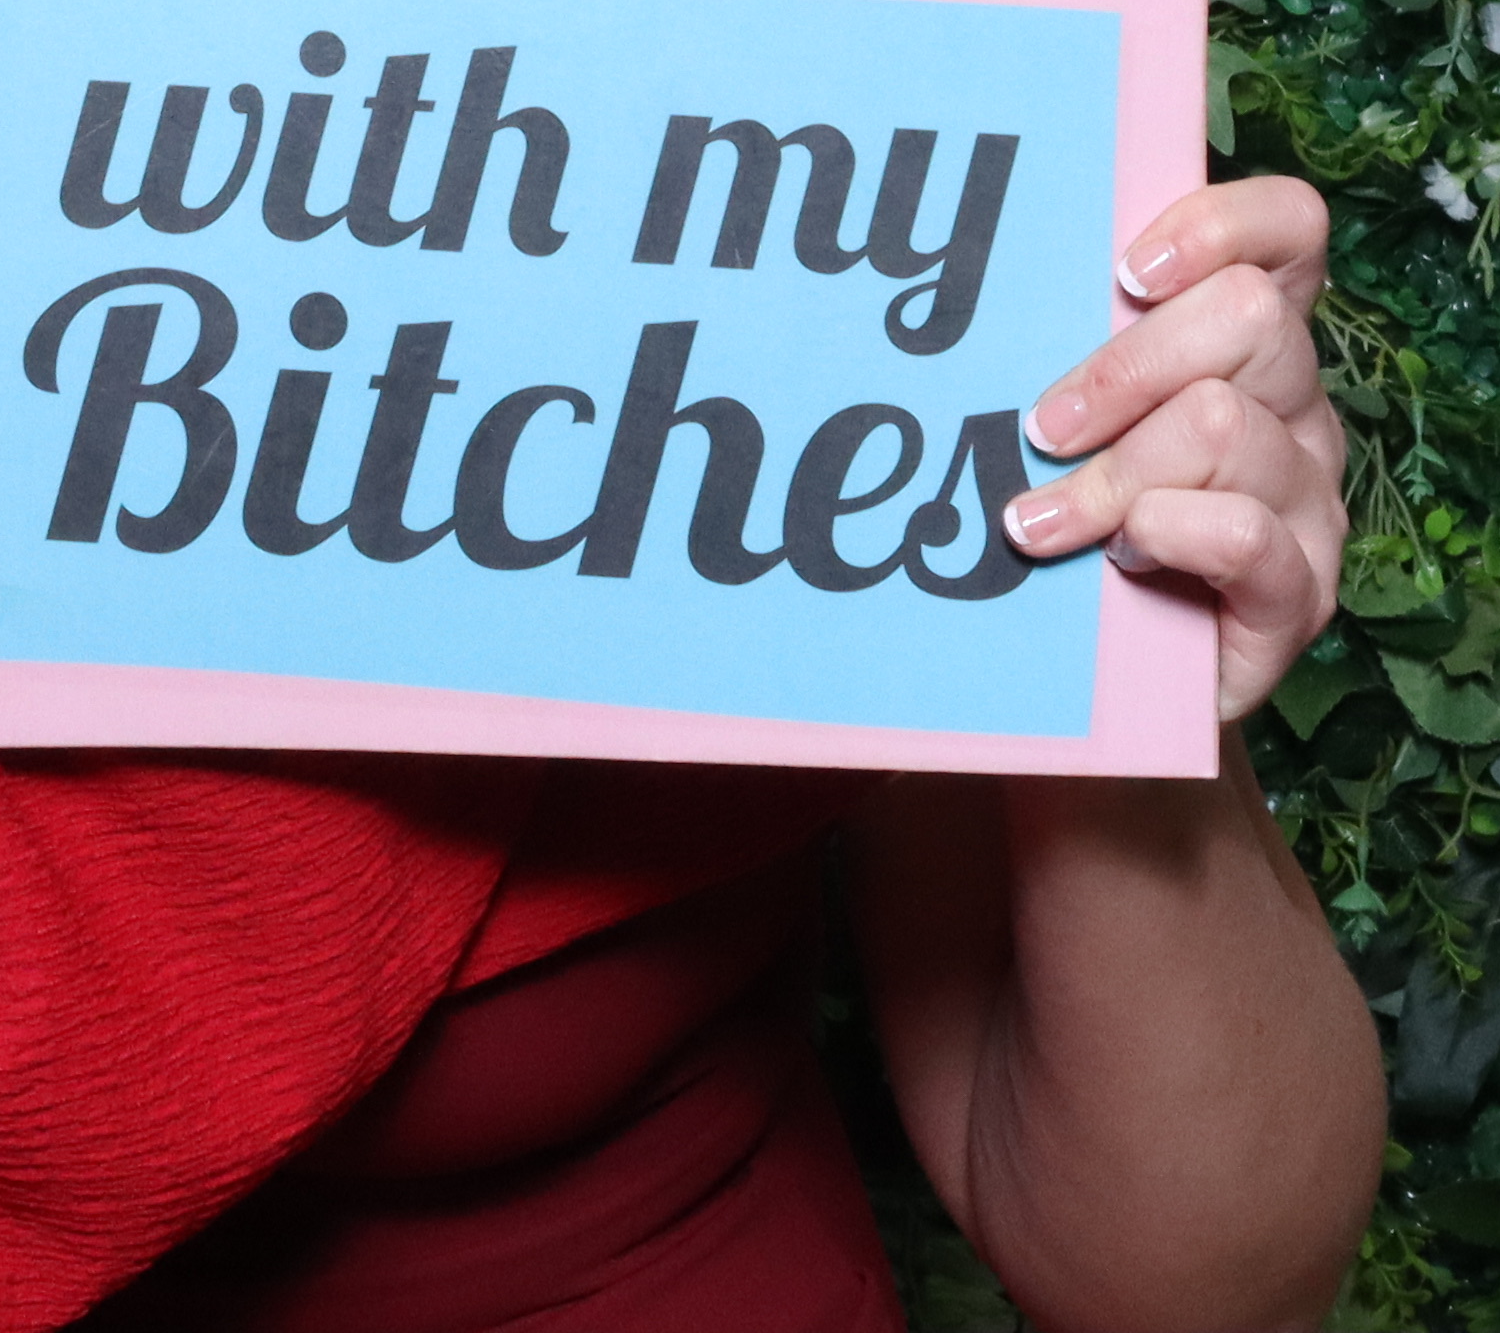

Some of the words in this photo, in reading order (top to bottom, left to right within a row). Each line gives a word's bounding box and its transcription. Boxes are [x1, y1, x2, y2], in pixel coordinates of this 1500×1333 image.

[58, 29, 571, 258] with
[632, 113, 1021, 356] my
[22, 267, 1035, 601] Bitches
